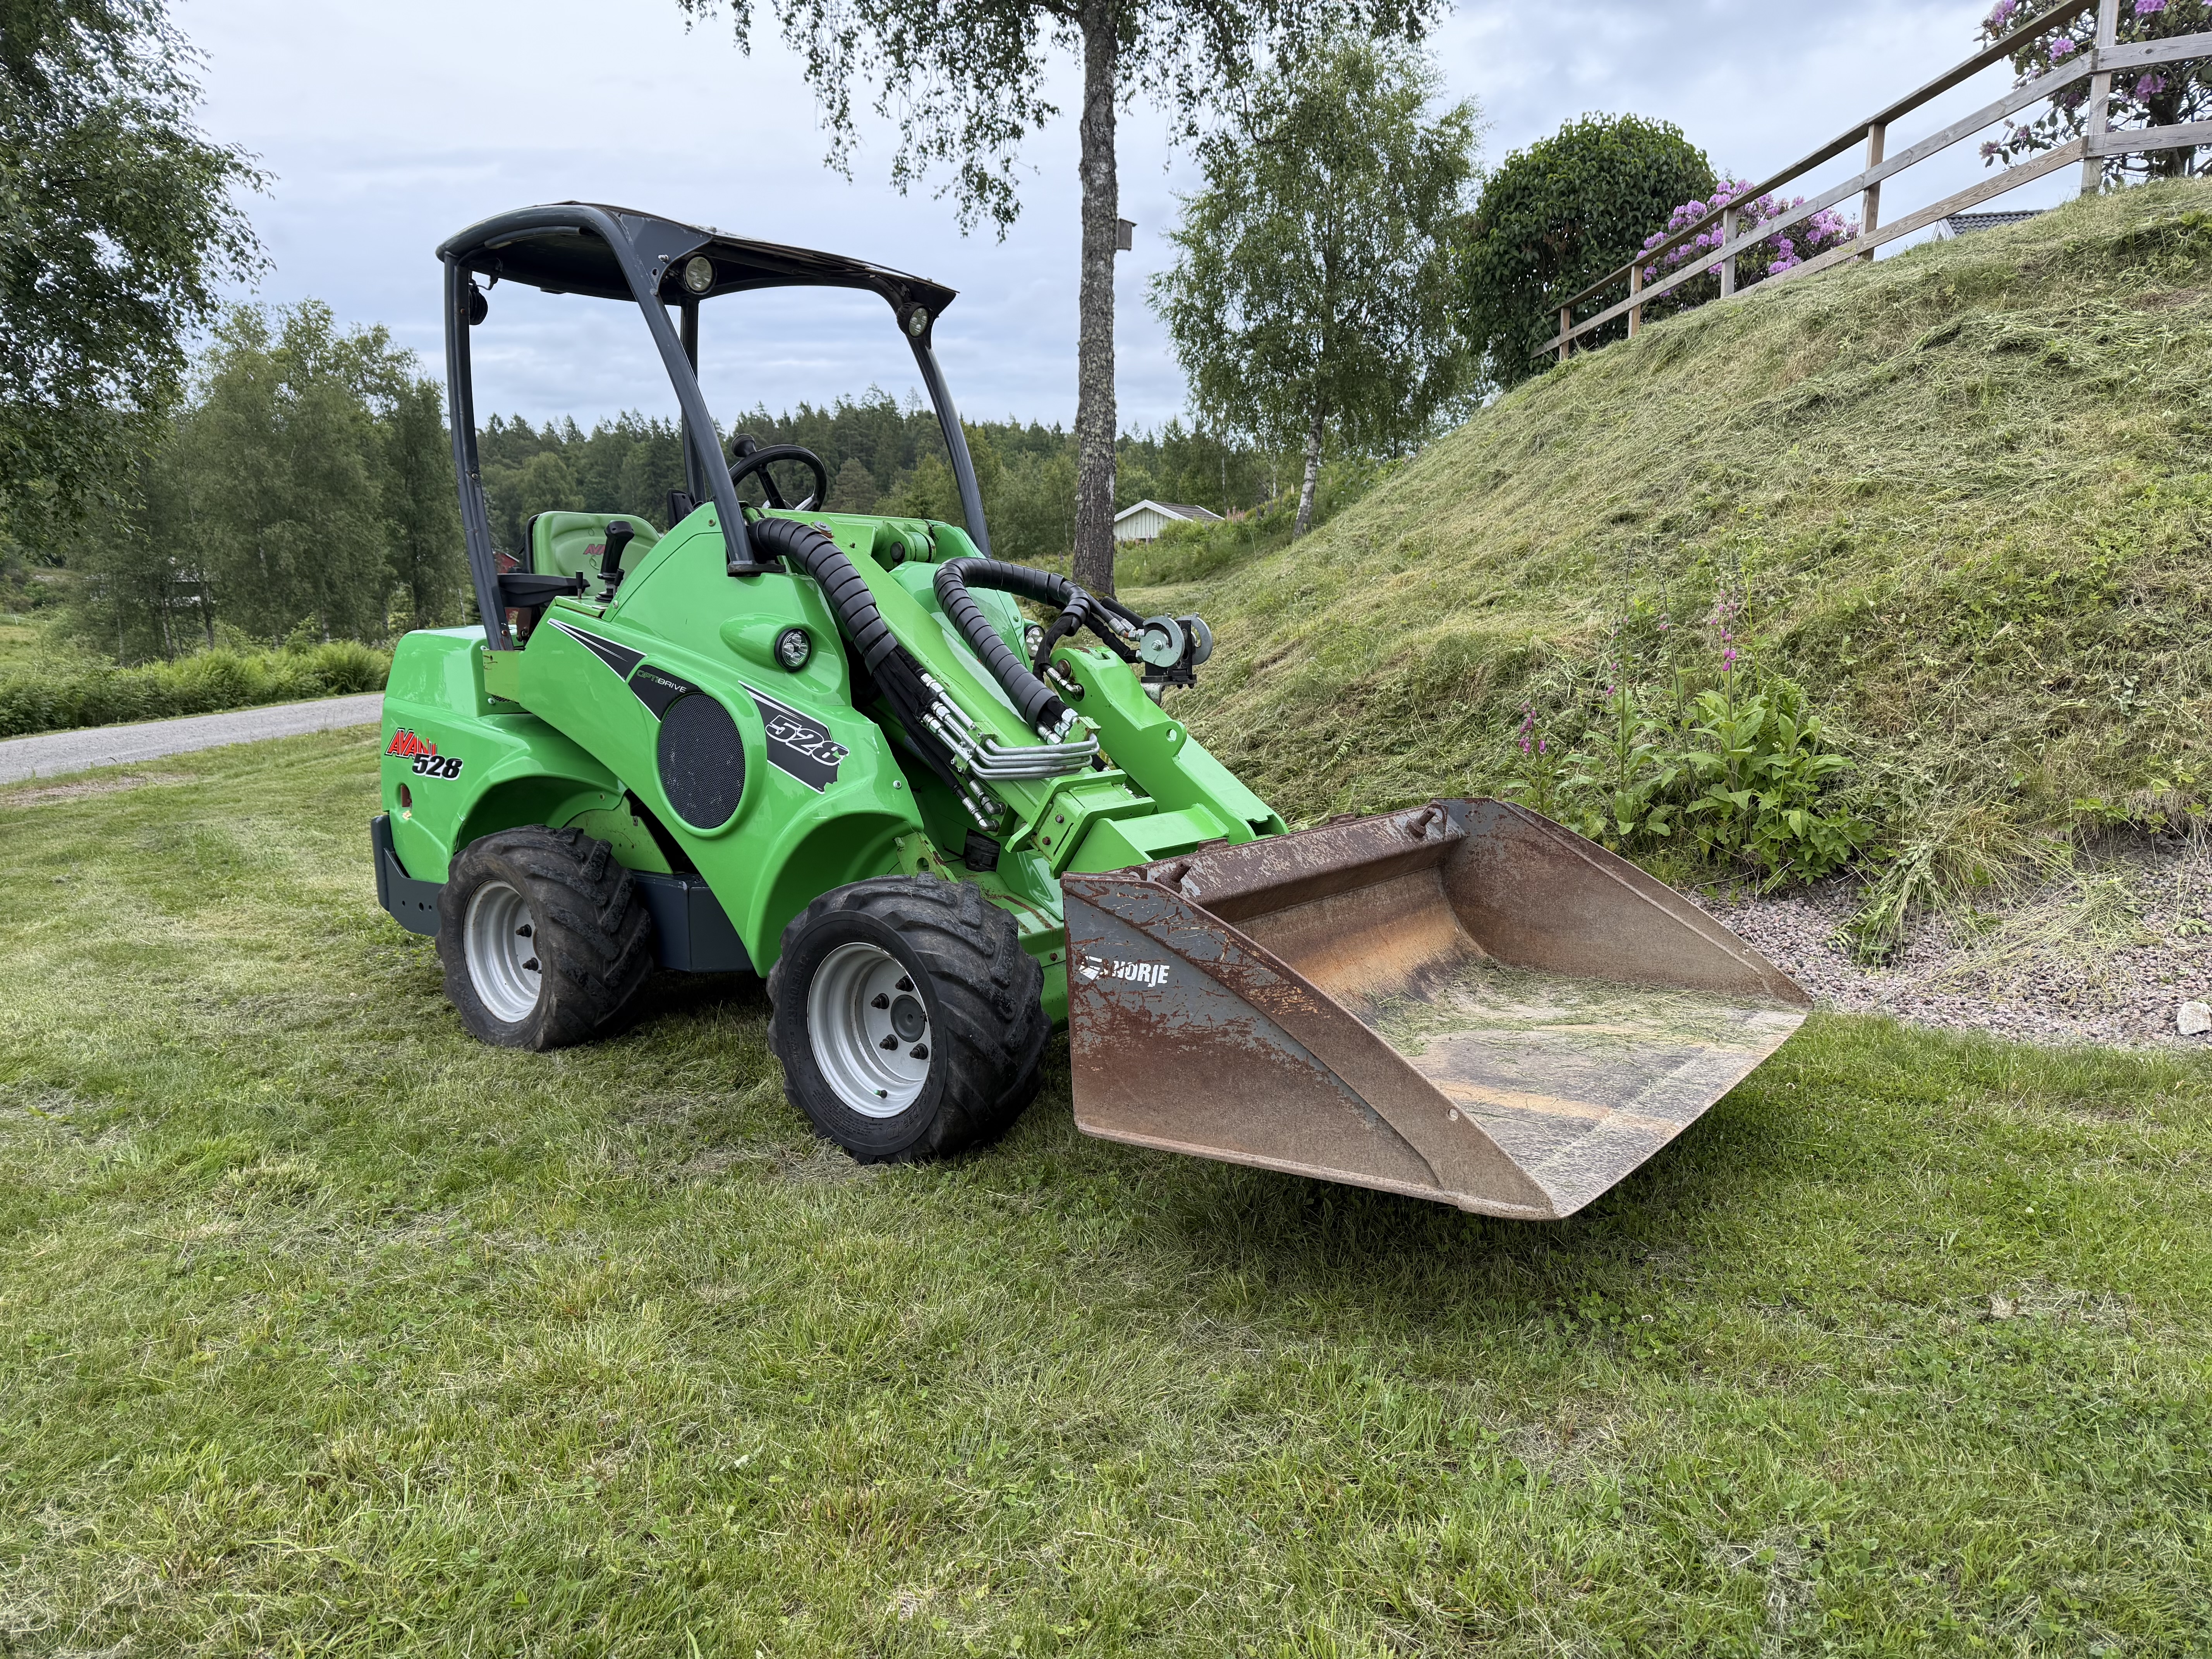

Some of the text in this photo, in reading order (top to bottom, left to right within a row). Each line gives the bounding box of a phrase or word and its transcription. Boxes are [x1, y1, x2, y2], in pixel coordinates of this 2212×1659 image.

[583, 544, 606, 555] AVA
[637, 670, 687, 693] OPTIDRIVE
[765, 714, 849, 766] 528
[412, 754, 463, 780] 528
